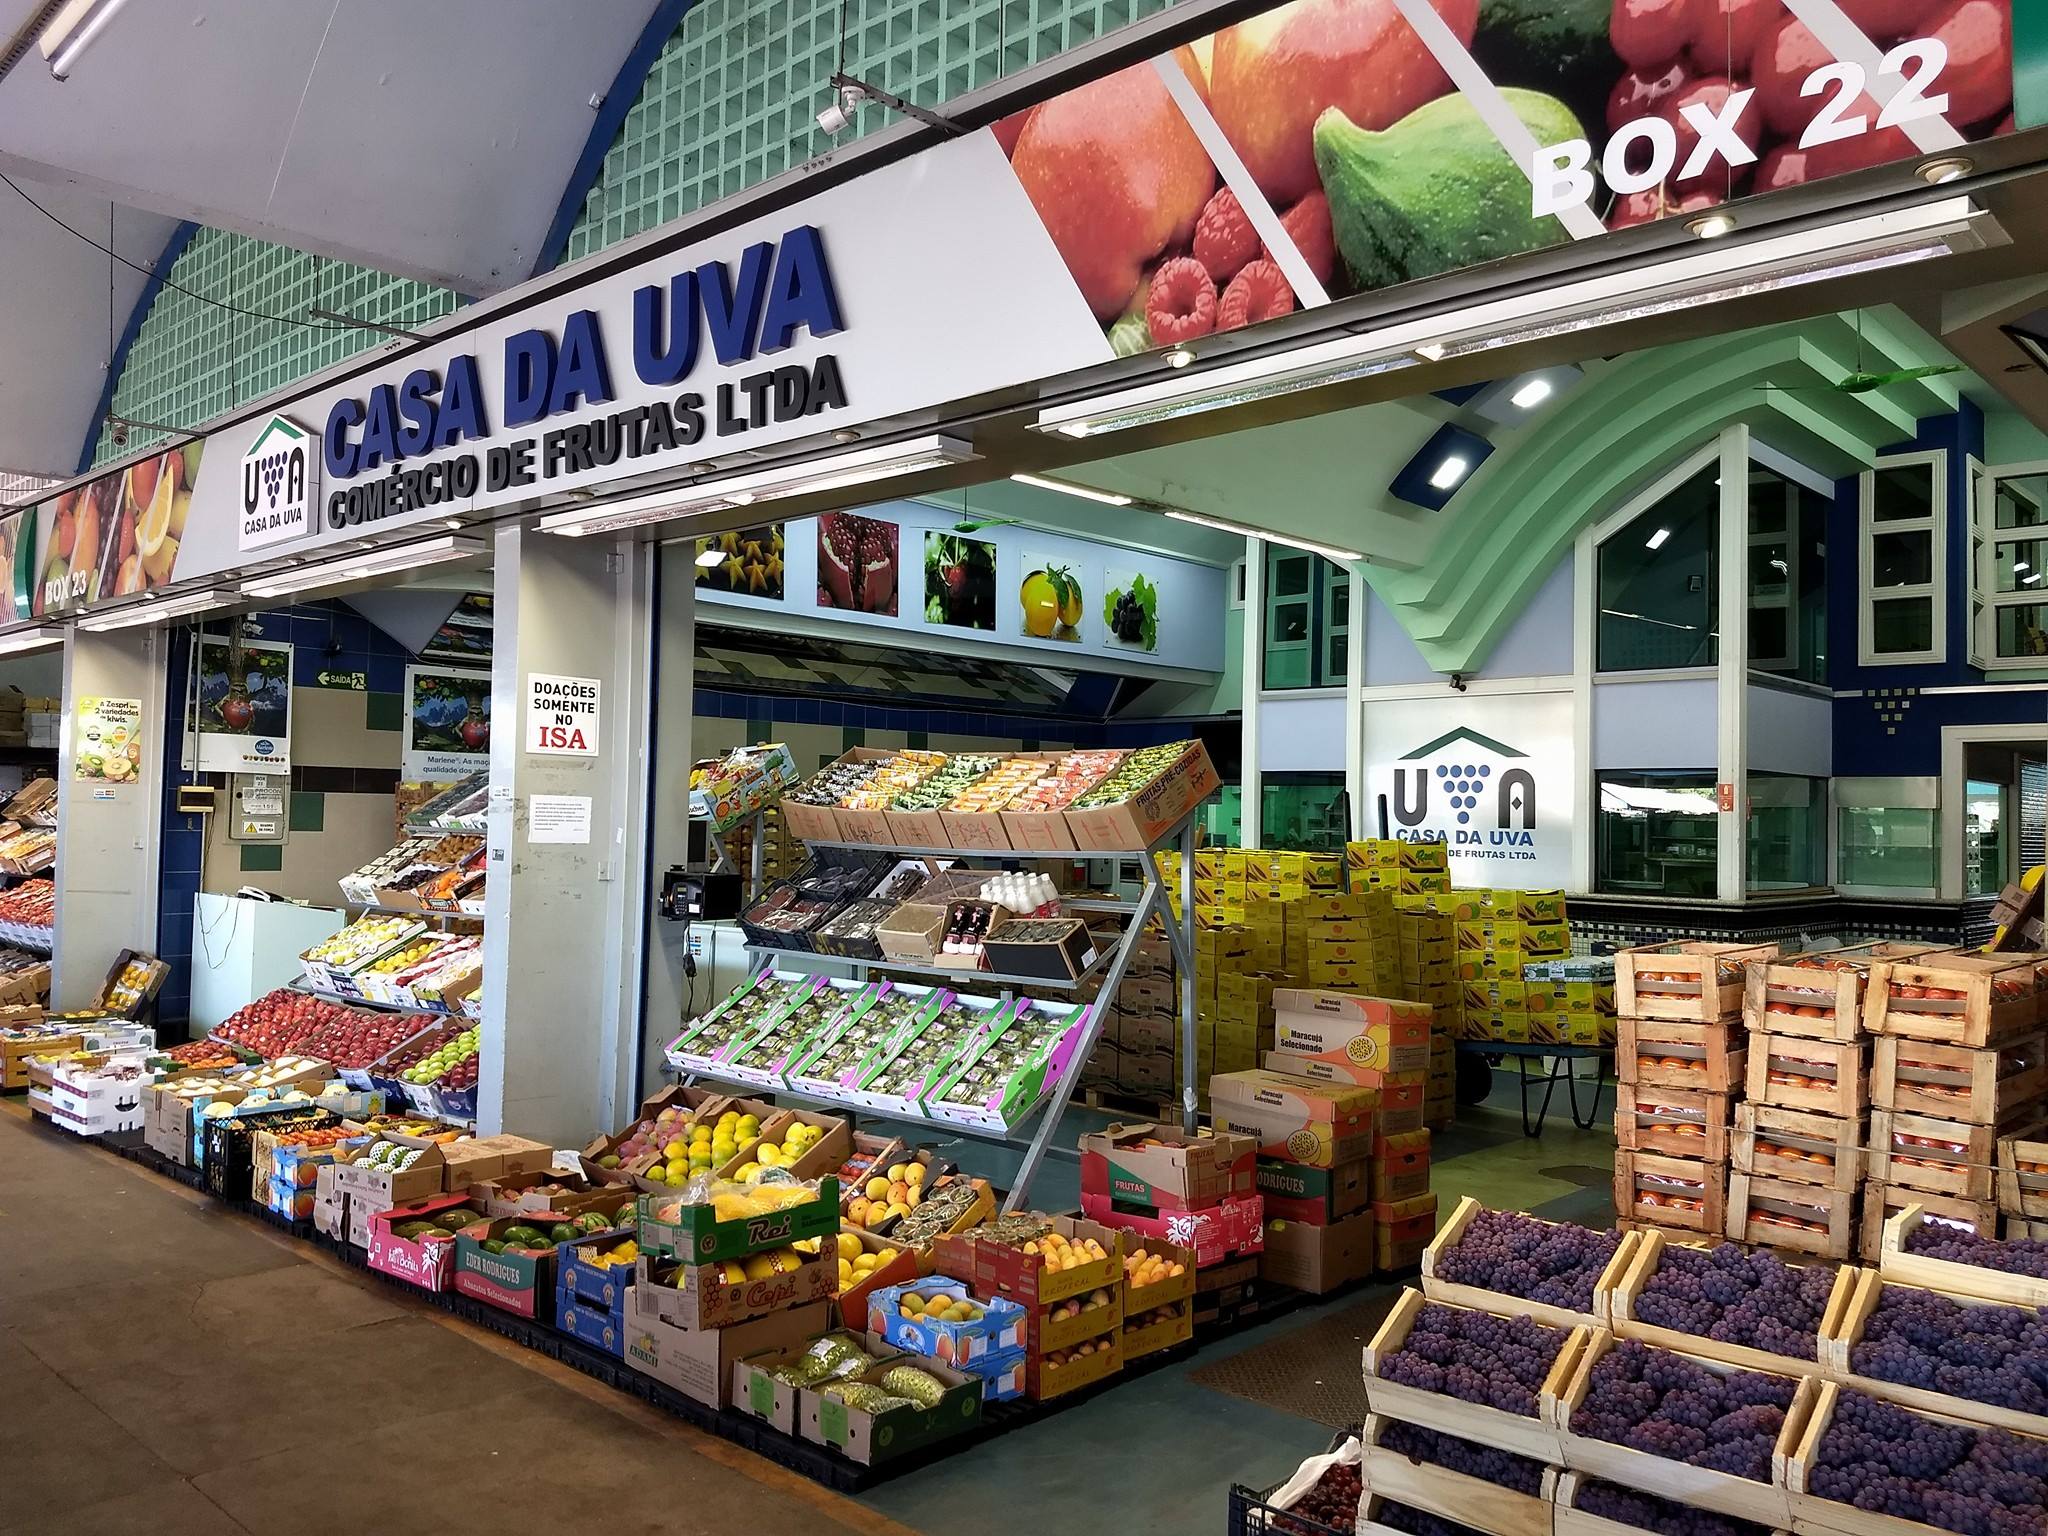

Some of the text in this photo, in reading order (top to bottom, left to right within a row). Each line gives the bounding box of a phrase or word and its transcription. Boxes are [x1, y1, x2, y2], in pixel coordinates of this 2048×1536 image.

[1532, 37, 1949, 219] BOX 22
[325, 225, 845, 480] CASA DA UVA
[328, 354, 849, 529] COMÉRCIO DE FRUTAS LTDA
[244, 507, 302, 536] CASA DA UVA
[45, 569, 86, 605] BOX 23
[330, 674, 351, 684] SAÍDA
[534, 682, 596, 699] DOAÇÕES
[533, 698, 595, 714] SOMENTE
[555, 714, 573, 726] NO
[539, 726, 587, 750] ISA
[423, 766, 457, 774] qualidade
[1396, 828, 1534, 847] CASA DA UVA
[1448, 849, 1537, 860] DE FRUTAS LTDA
[1290, 1029, 1323, 1043] Maracujá
[1280, 1038, 1323, 1054] Selecionado
[1306, 1069, 1332, 1079] Selecionado
[1313, 1063, 1333, 1073] Maracujá
[1253, 1094, 1282, 1106] Selecionado
[1261, 1088, 1283, 1099] Maracujá
[1228, 1121, 1262, 1138] Maracujá
[1115, 1179, 1145, 1193] FRUTAS
[1256, 1170, 1305, 1194] ODRIGUES
[747, 1214, 793, 1247] Rei
[466, 1251, 520, 1284] EDER RODRIGUES
[486, 1287, 521, 1309] Selecionados
[629, 1344, 659, 1368] ADAMI
